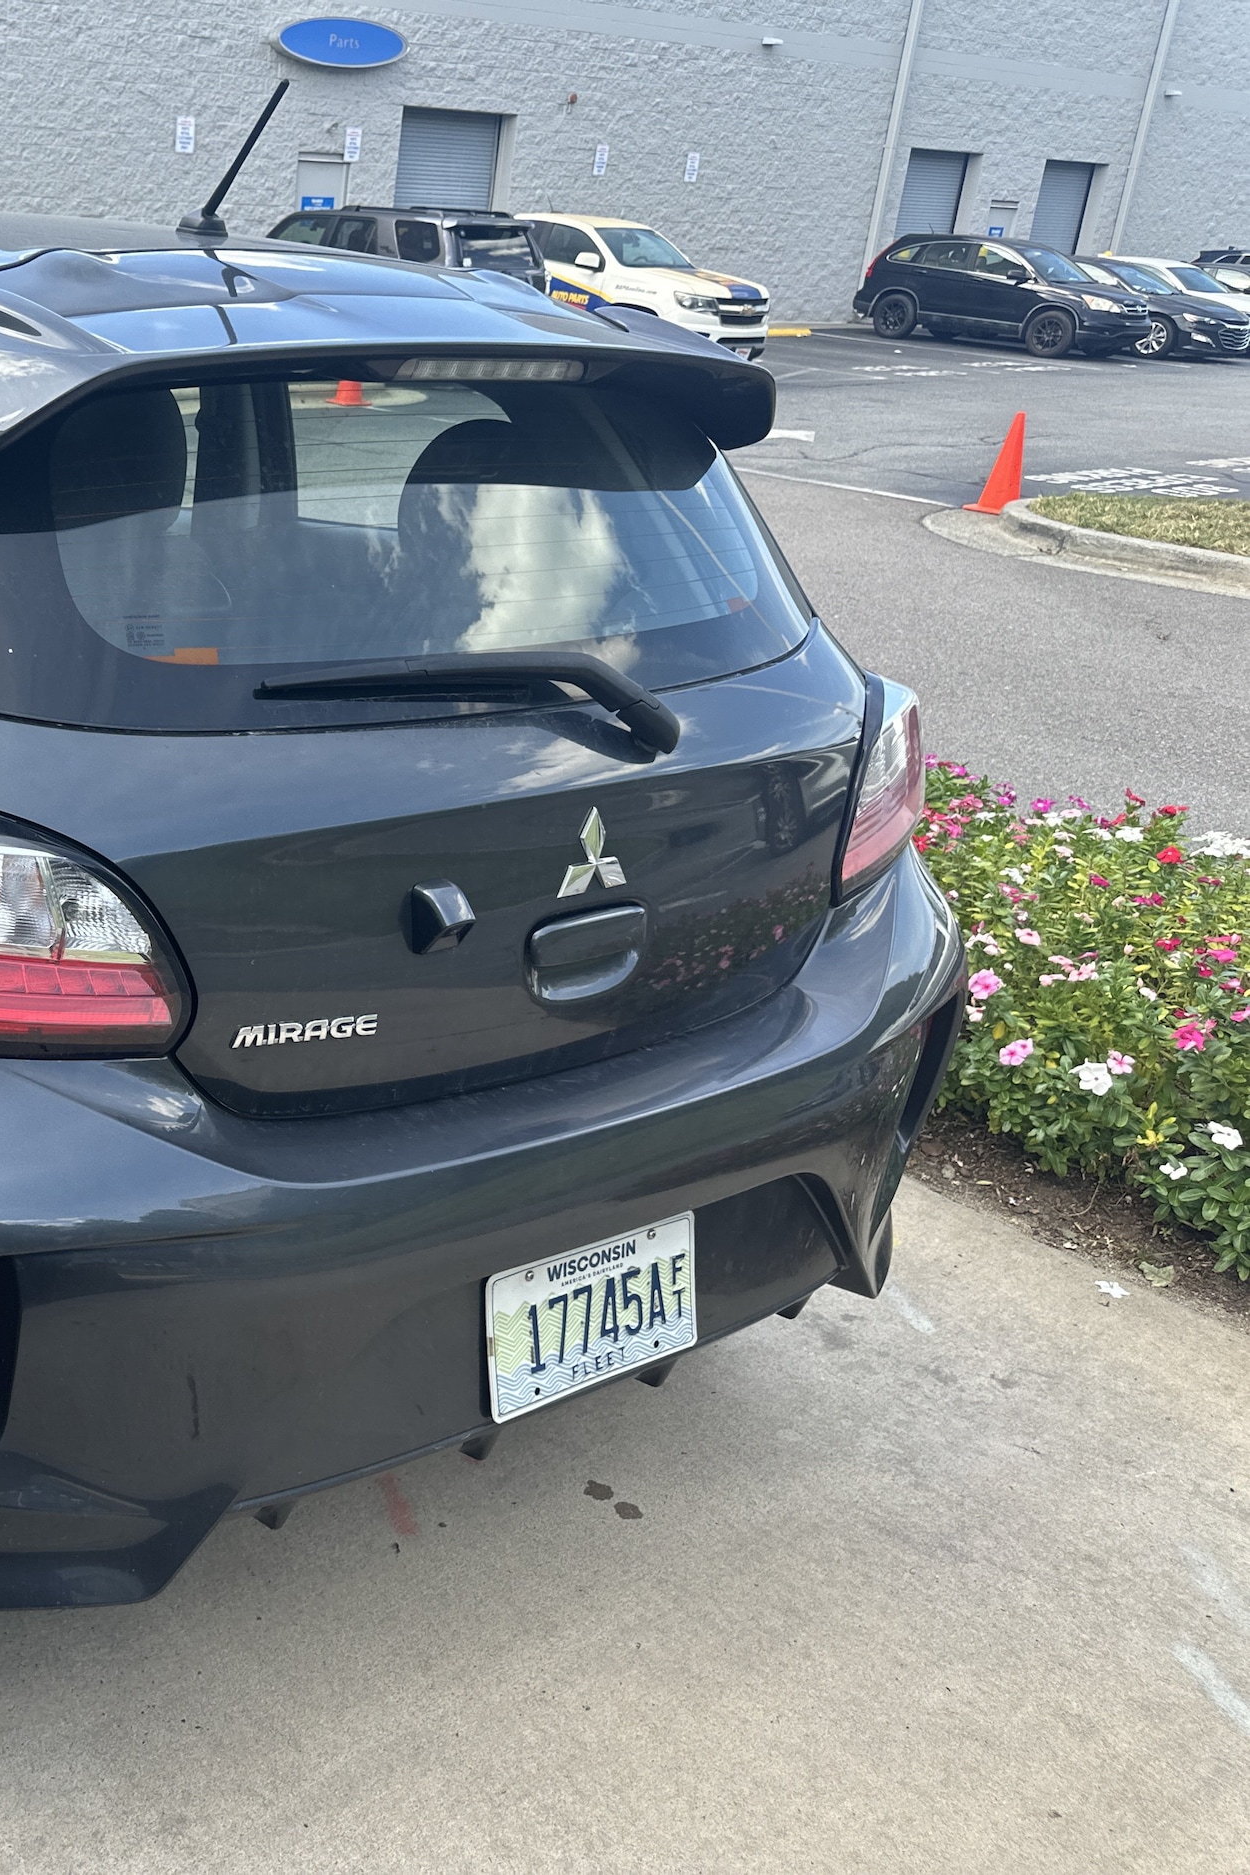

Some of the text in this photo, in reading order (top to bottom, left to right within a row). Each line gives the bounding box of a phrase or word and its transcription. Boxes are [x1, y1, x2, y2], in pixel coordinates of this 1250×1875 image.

[329, 33, 360, 49] Parts
[551, 290, 590, 305] AUTO PARTS
[232, 1014, 378, 1049] MIRAGE
[547, 1239, 636, 1282] WISCONSIN
[561, 1262, 624, 1287] AMERICA'S DAIRYLAND
[528, 1262, 667, 1374] 17745A
[571, 1347, 626, 1380] FLEET
